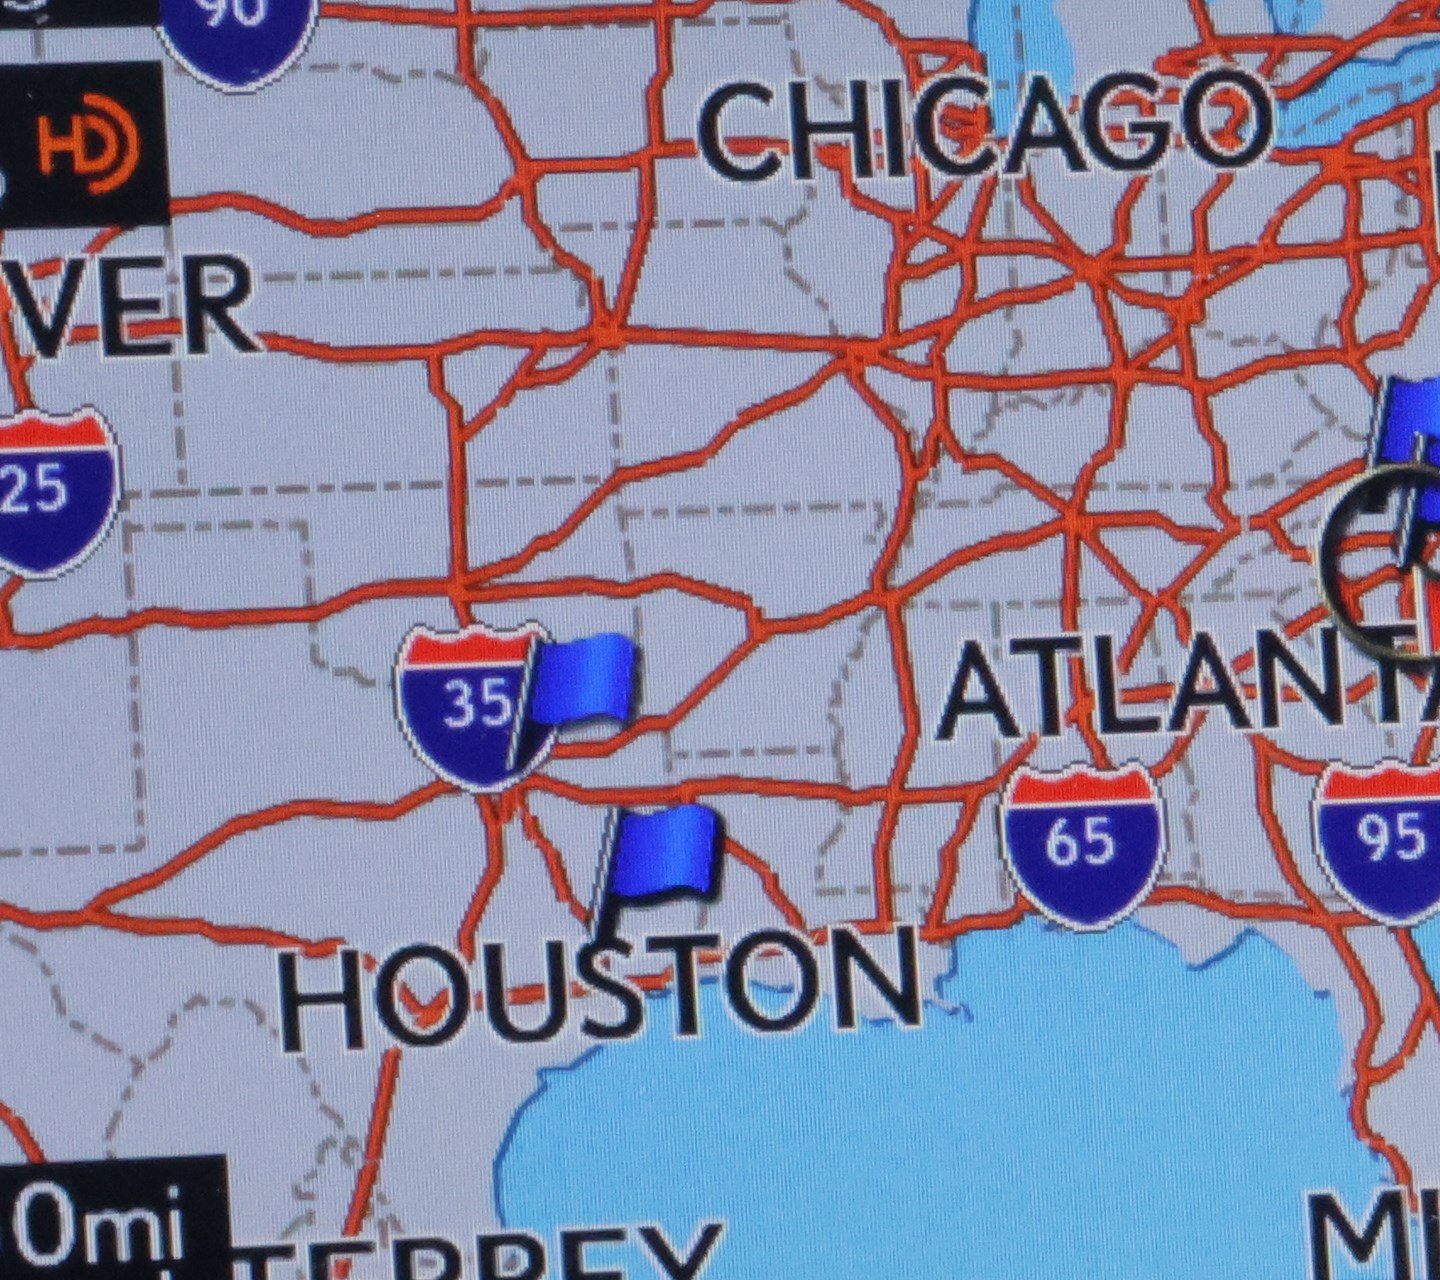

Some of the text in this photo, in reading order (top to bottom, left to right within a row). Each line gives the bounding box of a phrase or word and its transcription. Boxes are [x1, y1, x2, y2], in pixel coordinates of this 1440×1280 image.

[699, 68, 1275, 182] CHICAGO
[442, 679, 513, 728] 35
[1045, 817, 1116, 866] 65
[1357, 811, 1427, 861] 95
[278, 926, 921, 1052] HOUSTON
